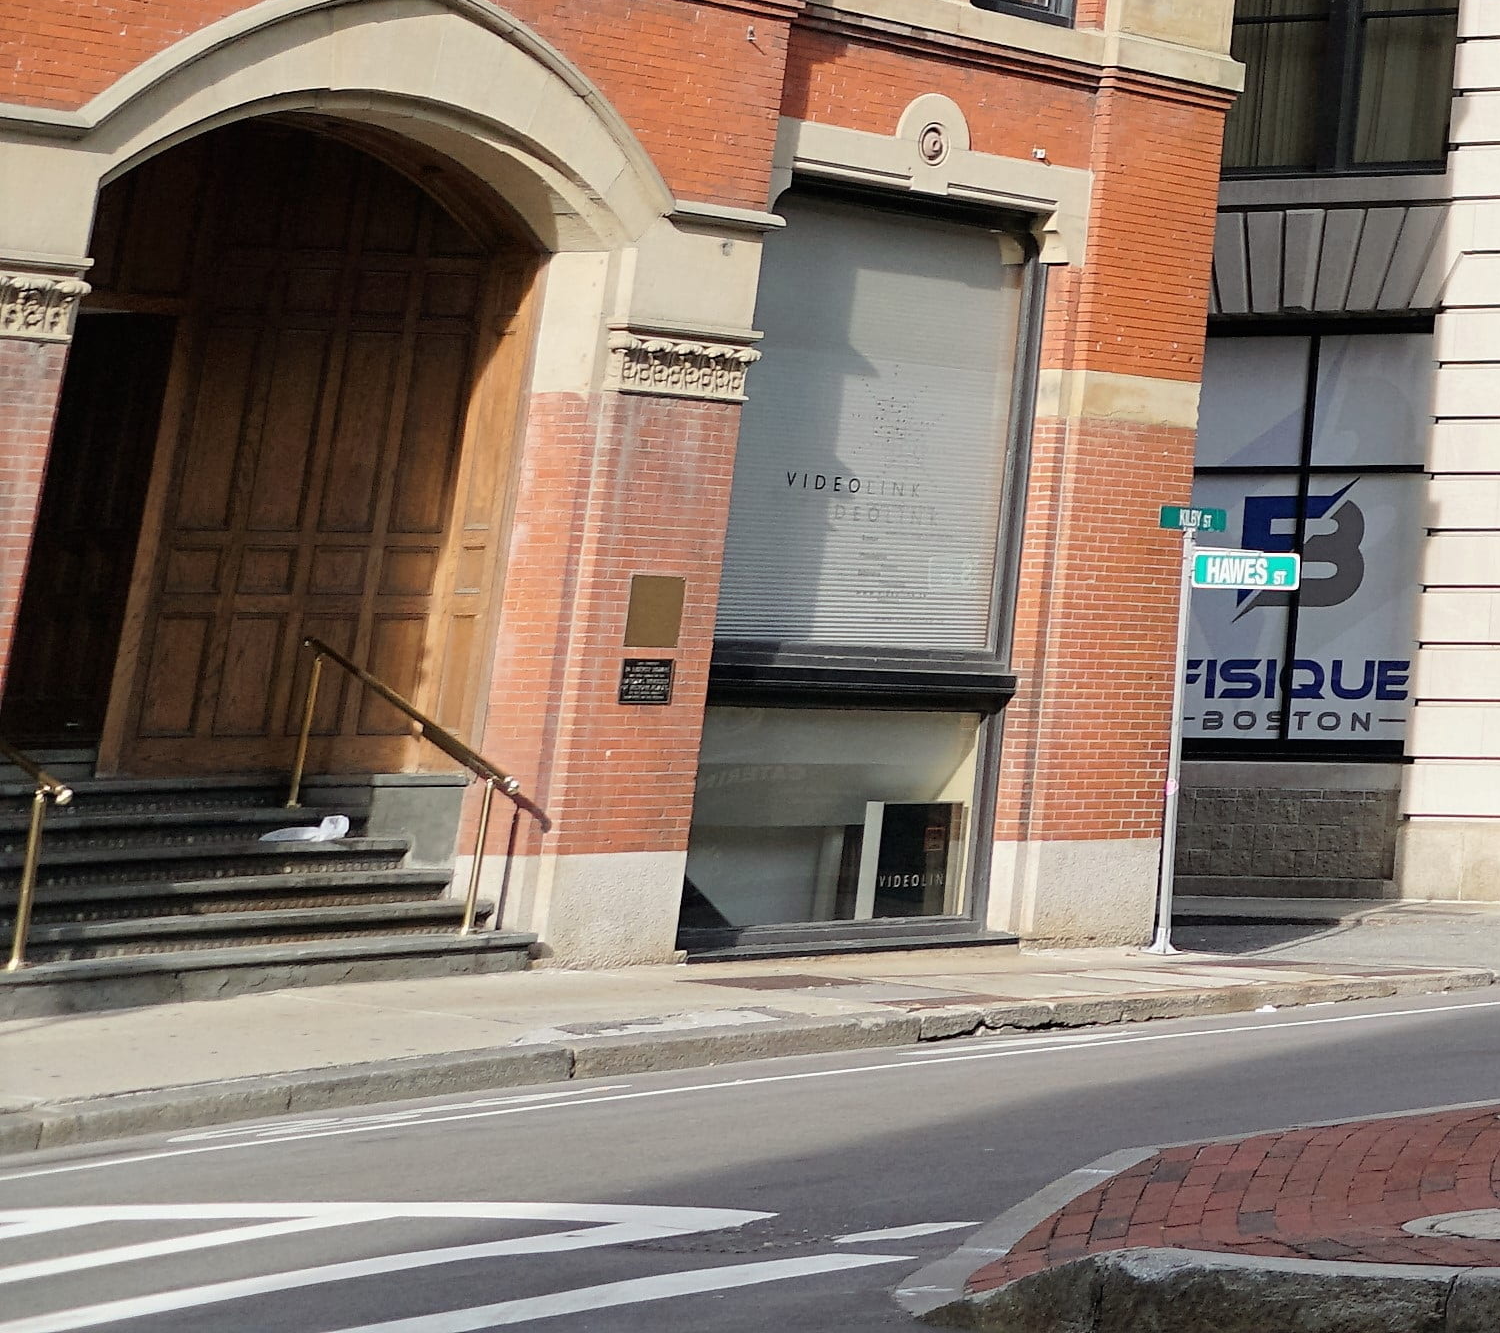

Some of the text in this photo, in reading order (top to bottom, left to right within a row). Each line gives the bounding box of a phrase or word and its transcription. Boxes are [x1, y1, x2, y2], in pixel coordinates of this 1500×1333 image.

[1179, 509, 1202, 528] KILBY
[1206, 556, 1288, 586] HAWES ST
[1202, 710, 1372, 732] BOSTON
